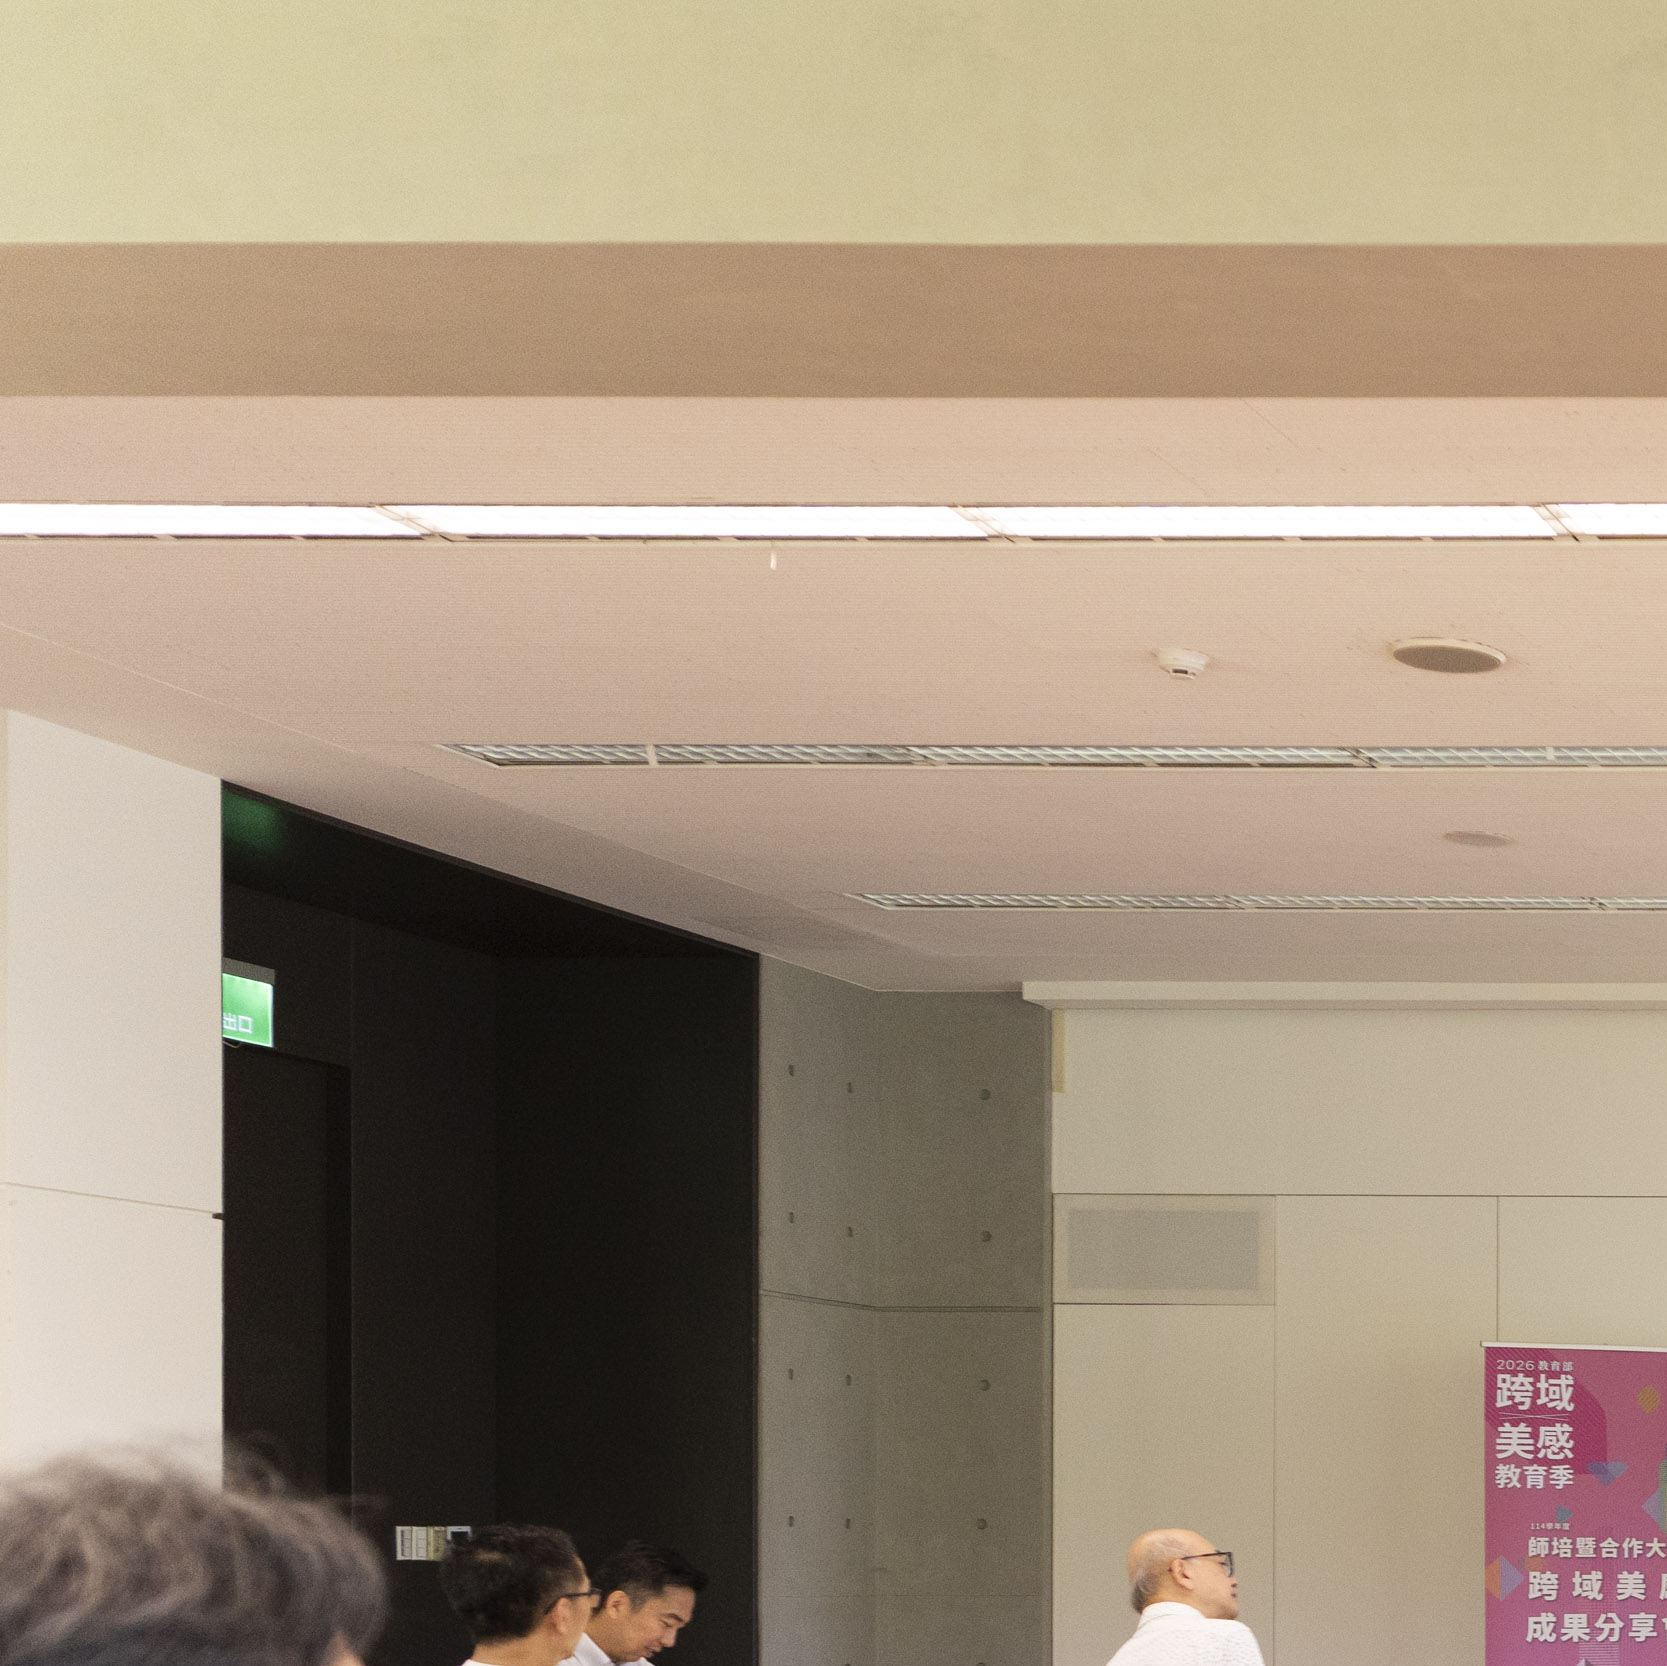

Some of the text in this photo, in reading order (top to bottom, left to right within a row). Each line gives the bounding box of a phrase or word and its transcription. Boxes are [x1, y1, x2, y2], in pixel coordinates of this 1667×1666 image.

[1496, 1359, 1574, 1372] 2026 教育部
[1495, 1373, 1575, 1412] 跨域
[1495, 1422, 1574, 1461] 美感
[1495, 1463, 1574, 1490] 教育季
